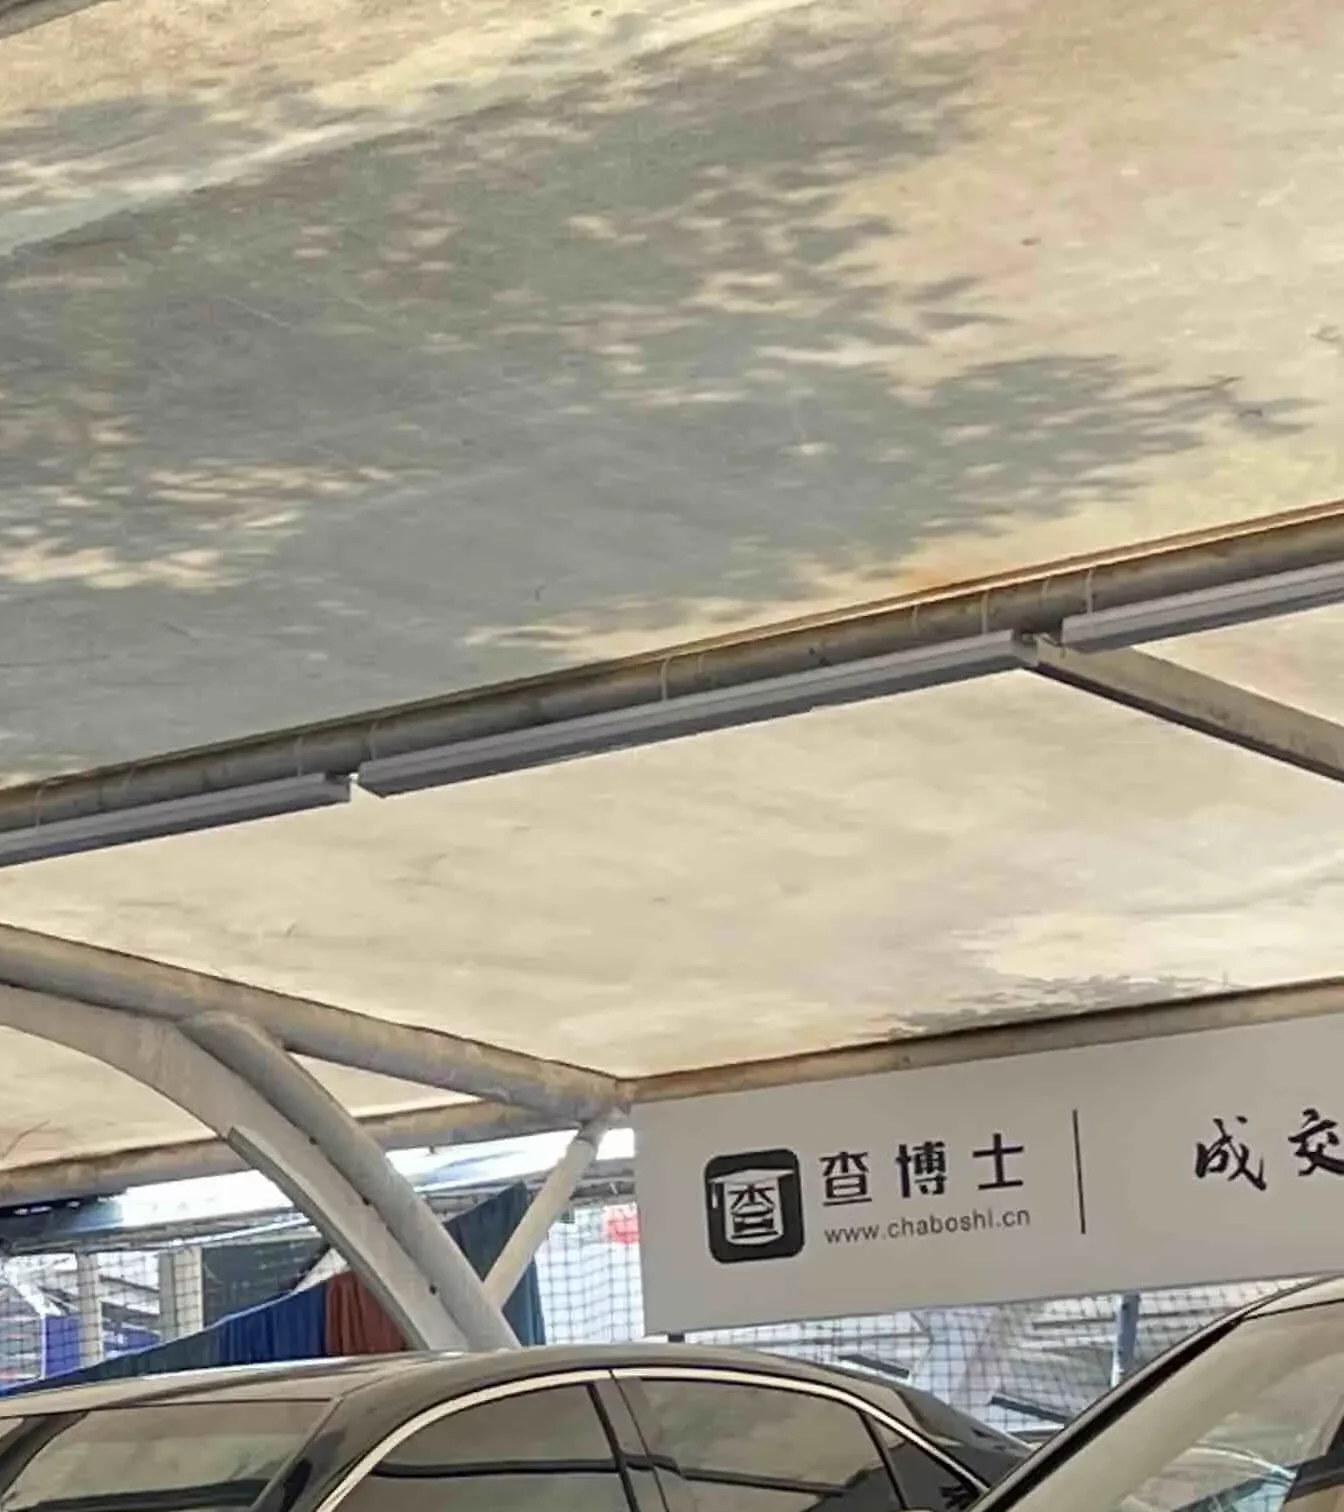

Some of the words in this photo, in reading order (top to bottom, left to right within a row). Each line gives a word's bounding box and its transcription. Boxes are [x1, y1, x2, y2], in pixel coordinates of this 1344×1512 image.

[819, 1132, 1025, 1207] 查博士
[1194, 1107, 1344, 1192] 成交
[823, 1206, 1031, 1245] www.chaboshi.cn
